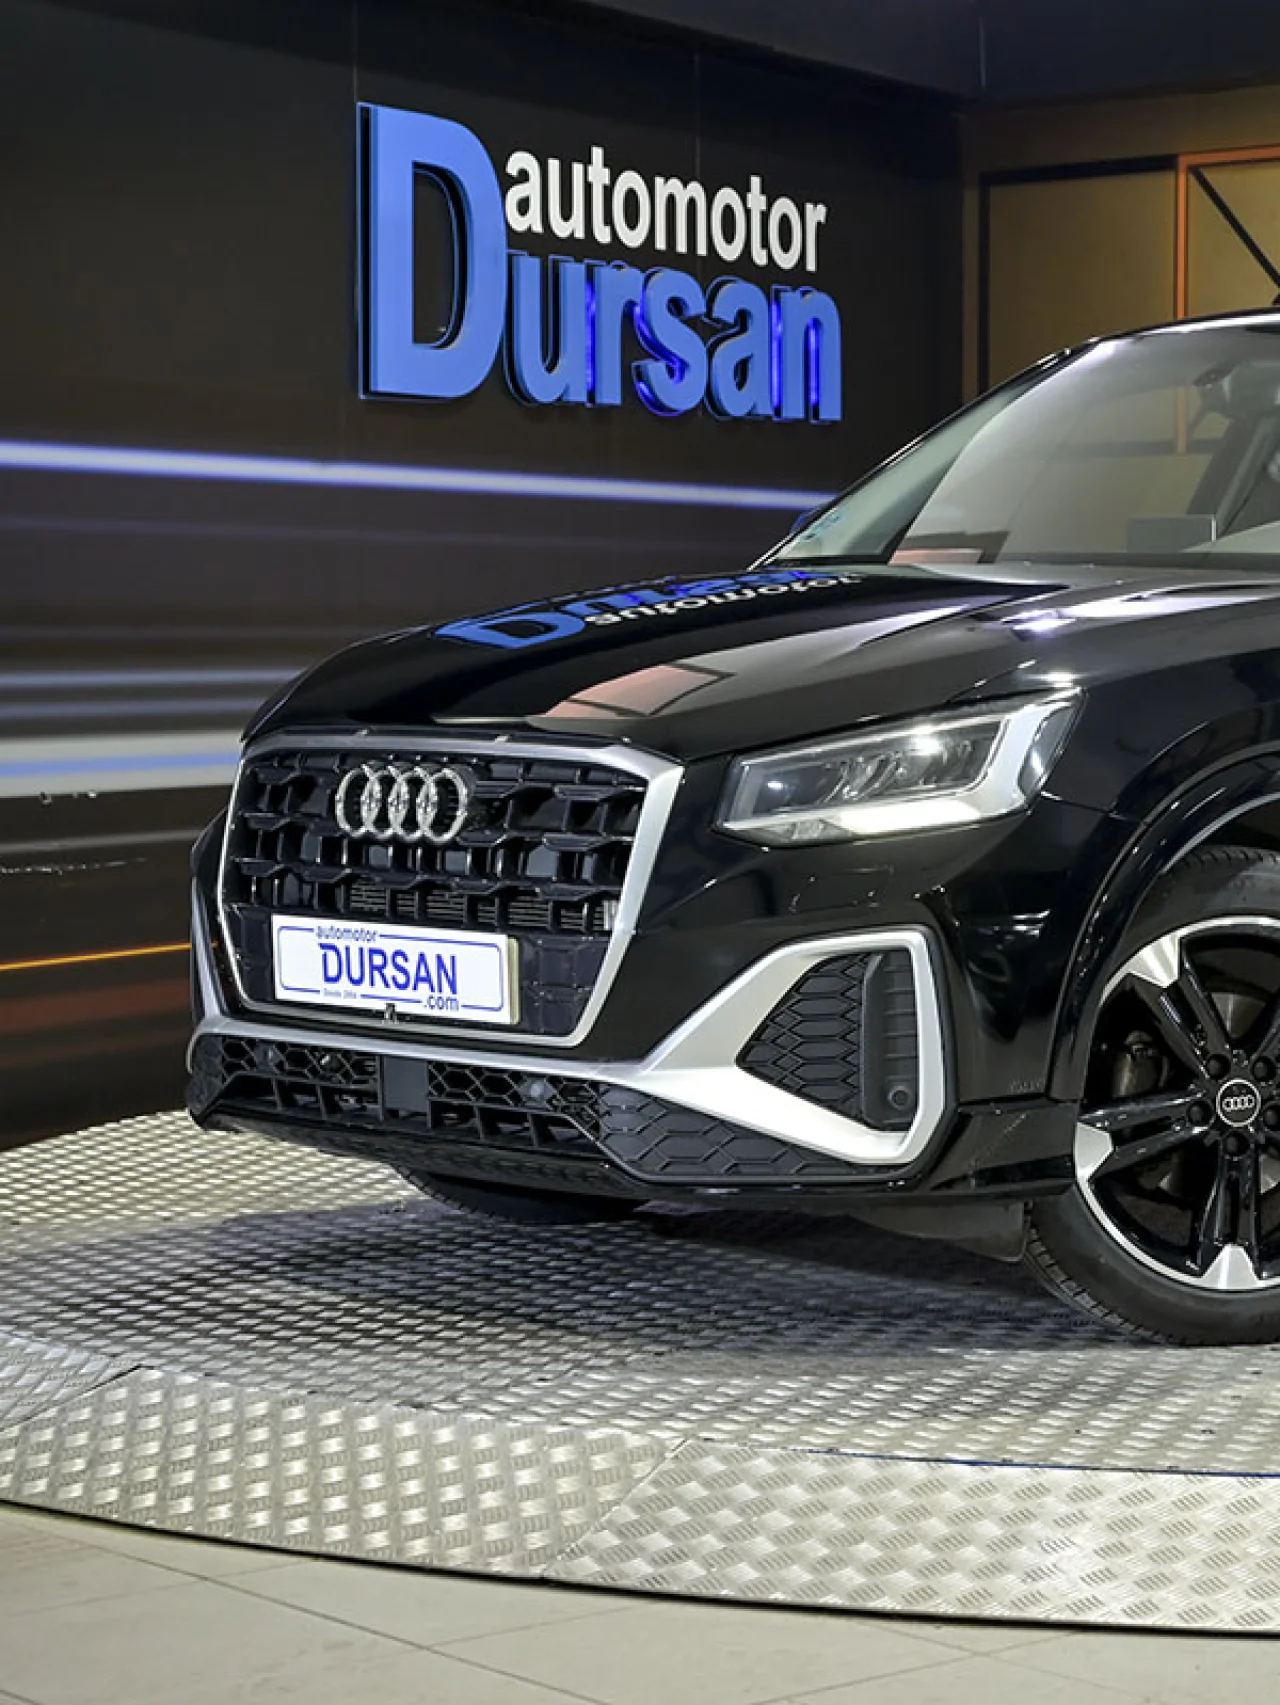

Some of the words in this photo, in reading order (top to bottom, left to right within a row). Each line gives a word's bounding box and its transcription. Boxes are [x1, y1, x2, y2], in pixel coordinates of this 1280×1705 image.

[504, 146, 827, 272] automotor
[356, 102, 843, 423] Dursan
[315, 925, 378, 943] automotor
[318, 942, 458, 995] DURSAN
